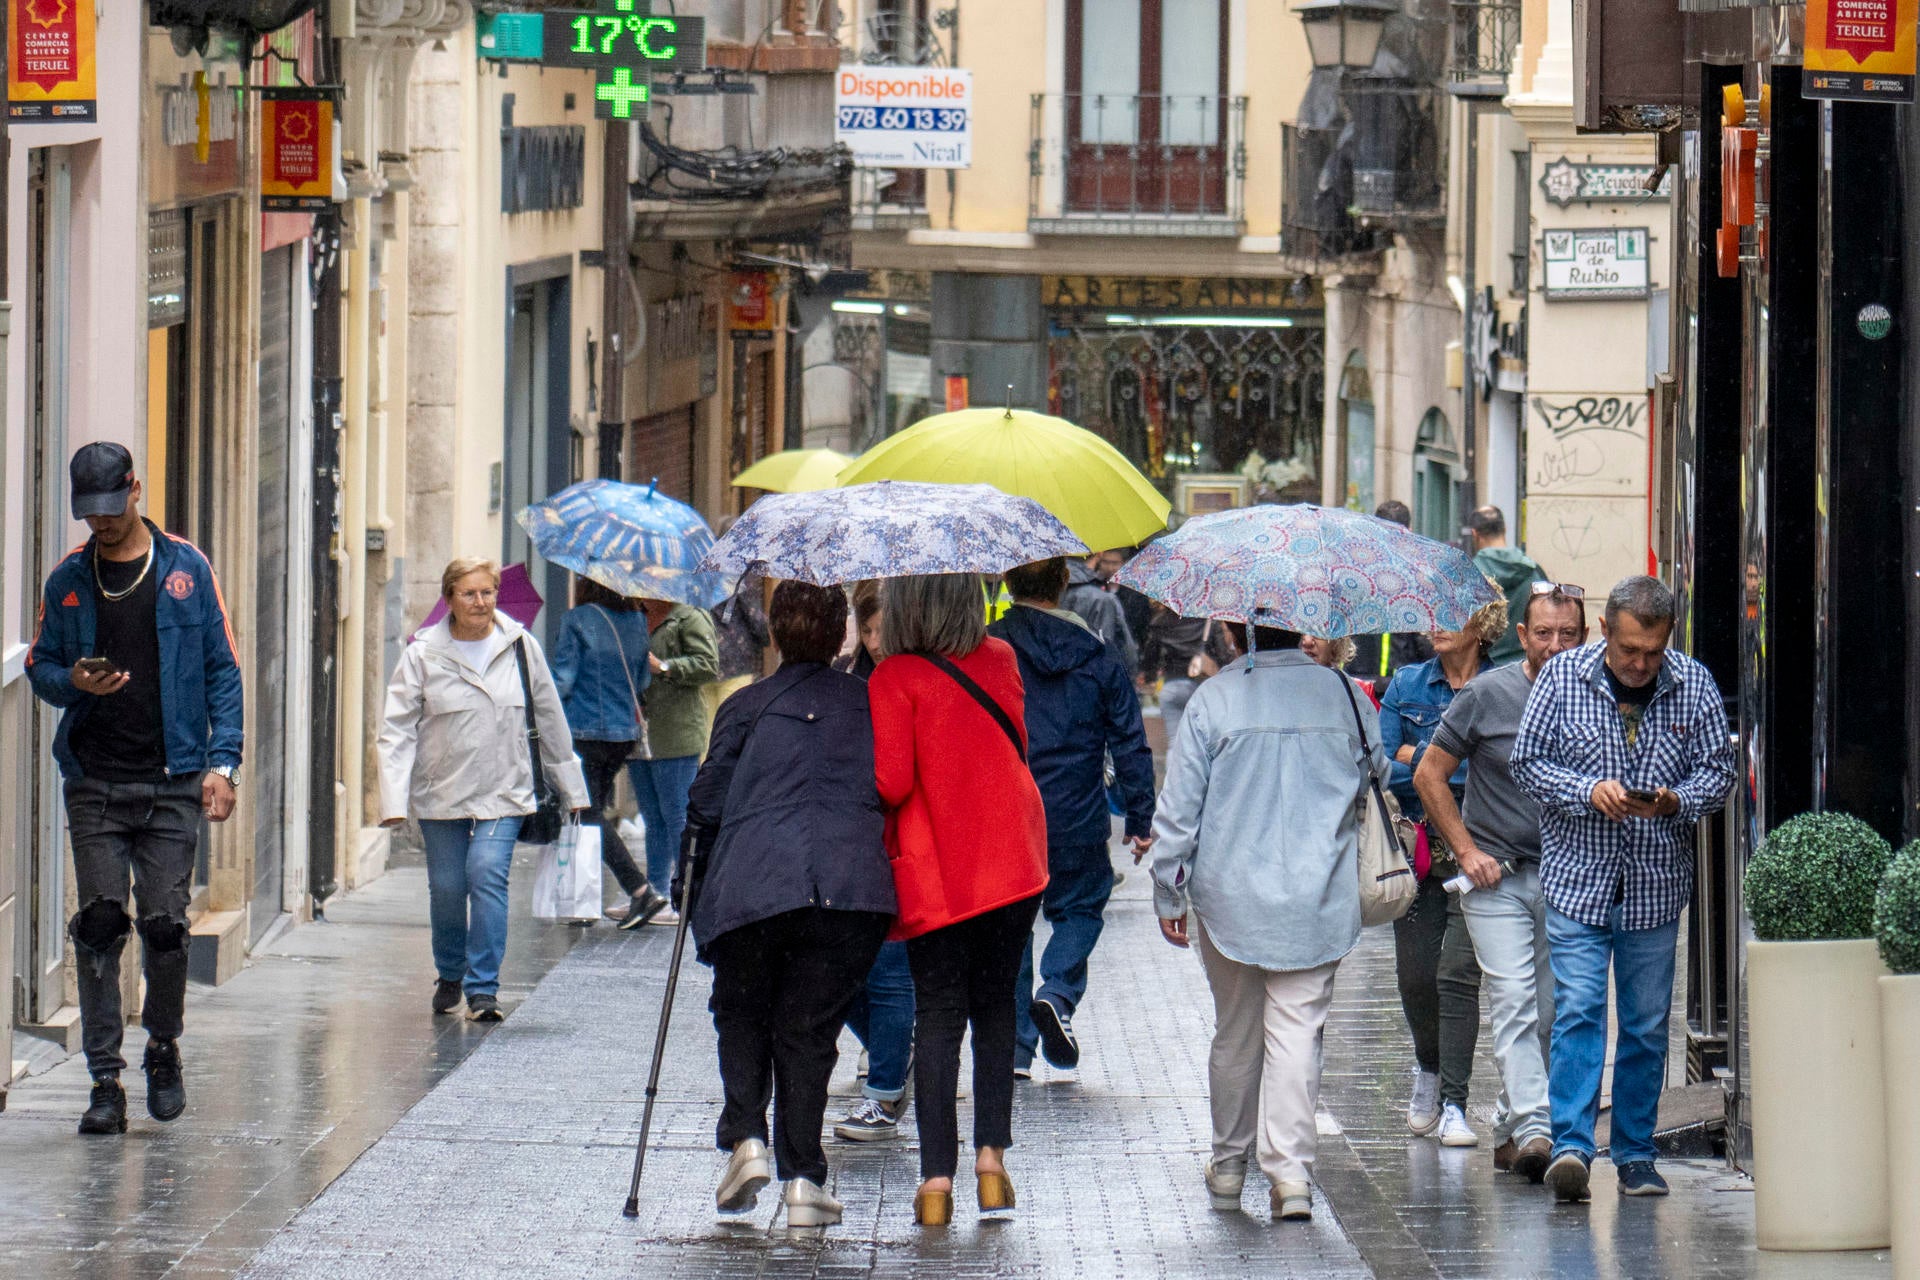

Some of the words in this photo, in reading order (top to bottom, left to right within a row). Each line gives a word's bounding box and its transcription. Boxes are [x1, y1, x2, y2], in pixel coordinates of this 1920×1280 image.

[1837, 1, 1887, 10] COMERCIAL
[1837, 10, 1887, 19] ABIERTO
[571, 14, 677, 59] 17°C
[1836, 24, 1886, 38] TERUEL
[25, 60, 70, 71] TERUEL
[841, 72, 965, 102] Disponible
[840, 107, 877, 129] 978
[881, 108, 909, 129] 60
[912, 109, 935, 130] 13
[937, 109, 965, 131] 39
[1578, 241, 1616, 256] Calle
[1587, 255, 1604, 266] de
[1568, 267, 1619, 284] Rubio
